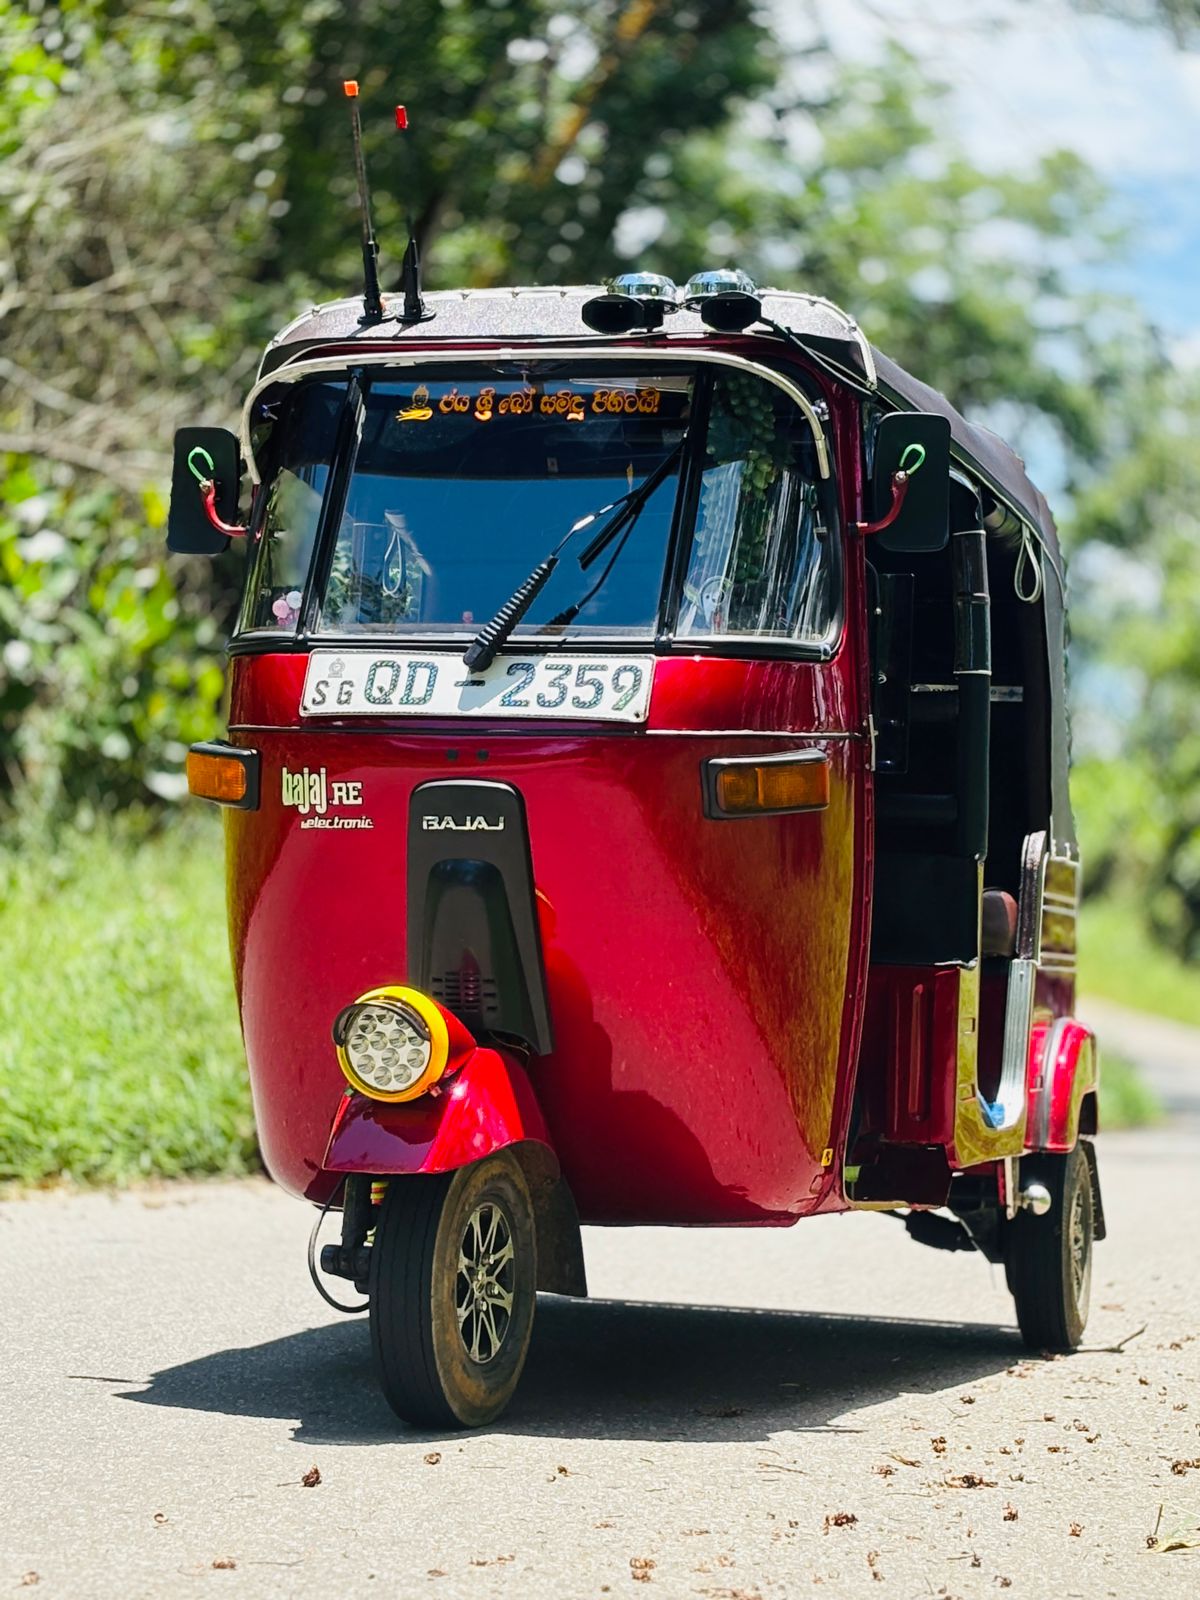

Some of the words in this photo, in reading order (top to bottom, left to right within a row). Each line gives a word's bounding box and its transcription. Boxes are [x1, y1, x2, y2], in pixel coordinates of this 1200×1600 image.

[439, 388, 470, 413] ජය
[499, 387, 537, 414] බෝ
[312, 680, 355, 706] SG
[364, 660, 439, 706] QD
[454, 680, 486, 688] -
[499, 662, 644, 712] 2359
[282, 767, 327, 814] bajaj
[301, 815, 374, 829] electronic
[422, 815, 505, 831] BAJAJ
